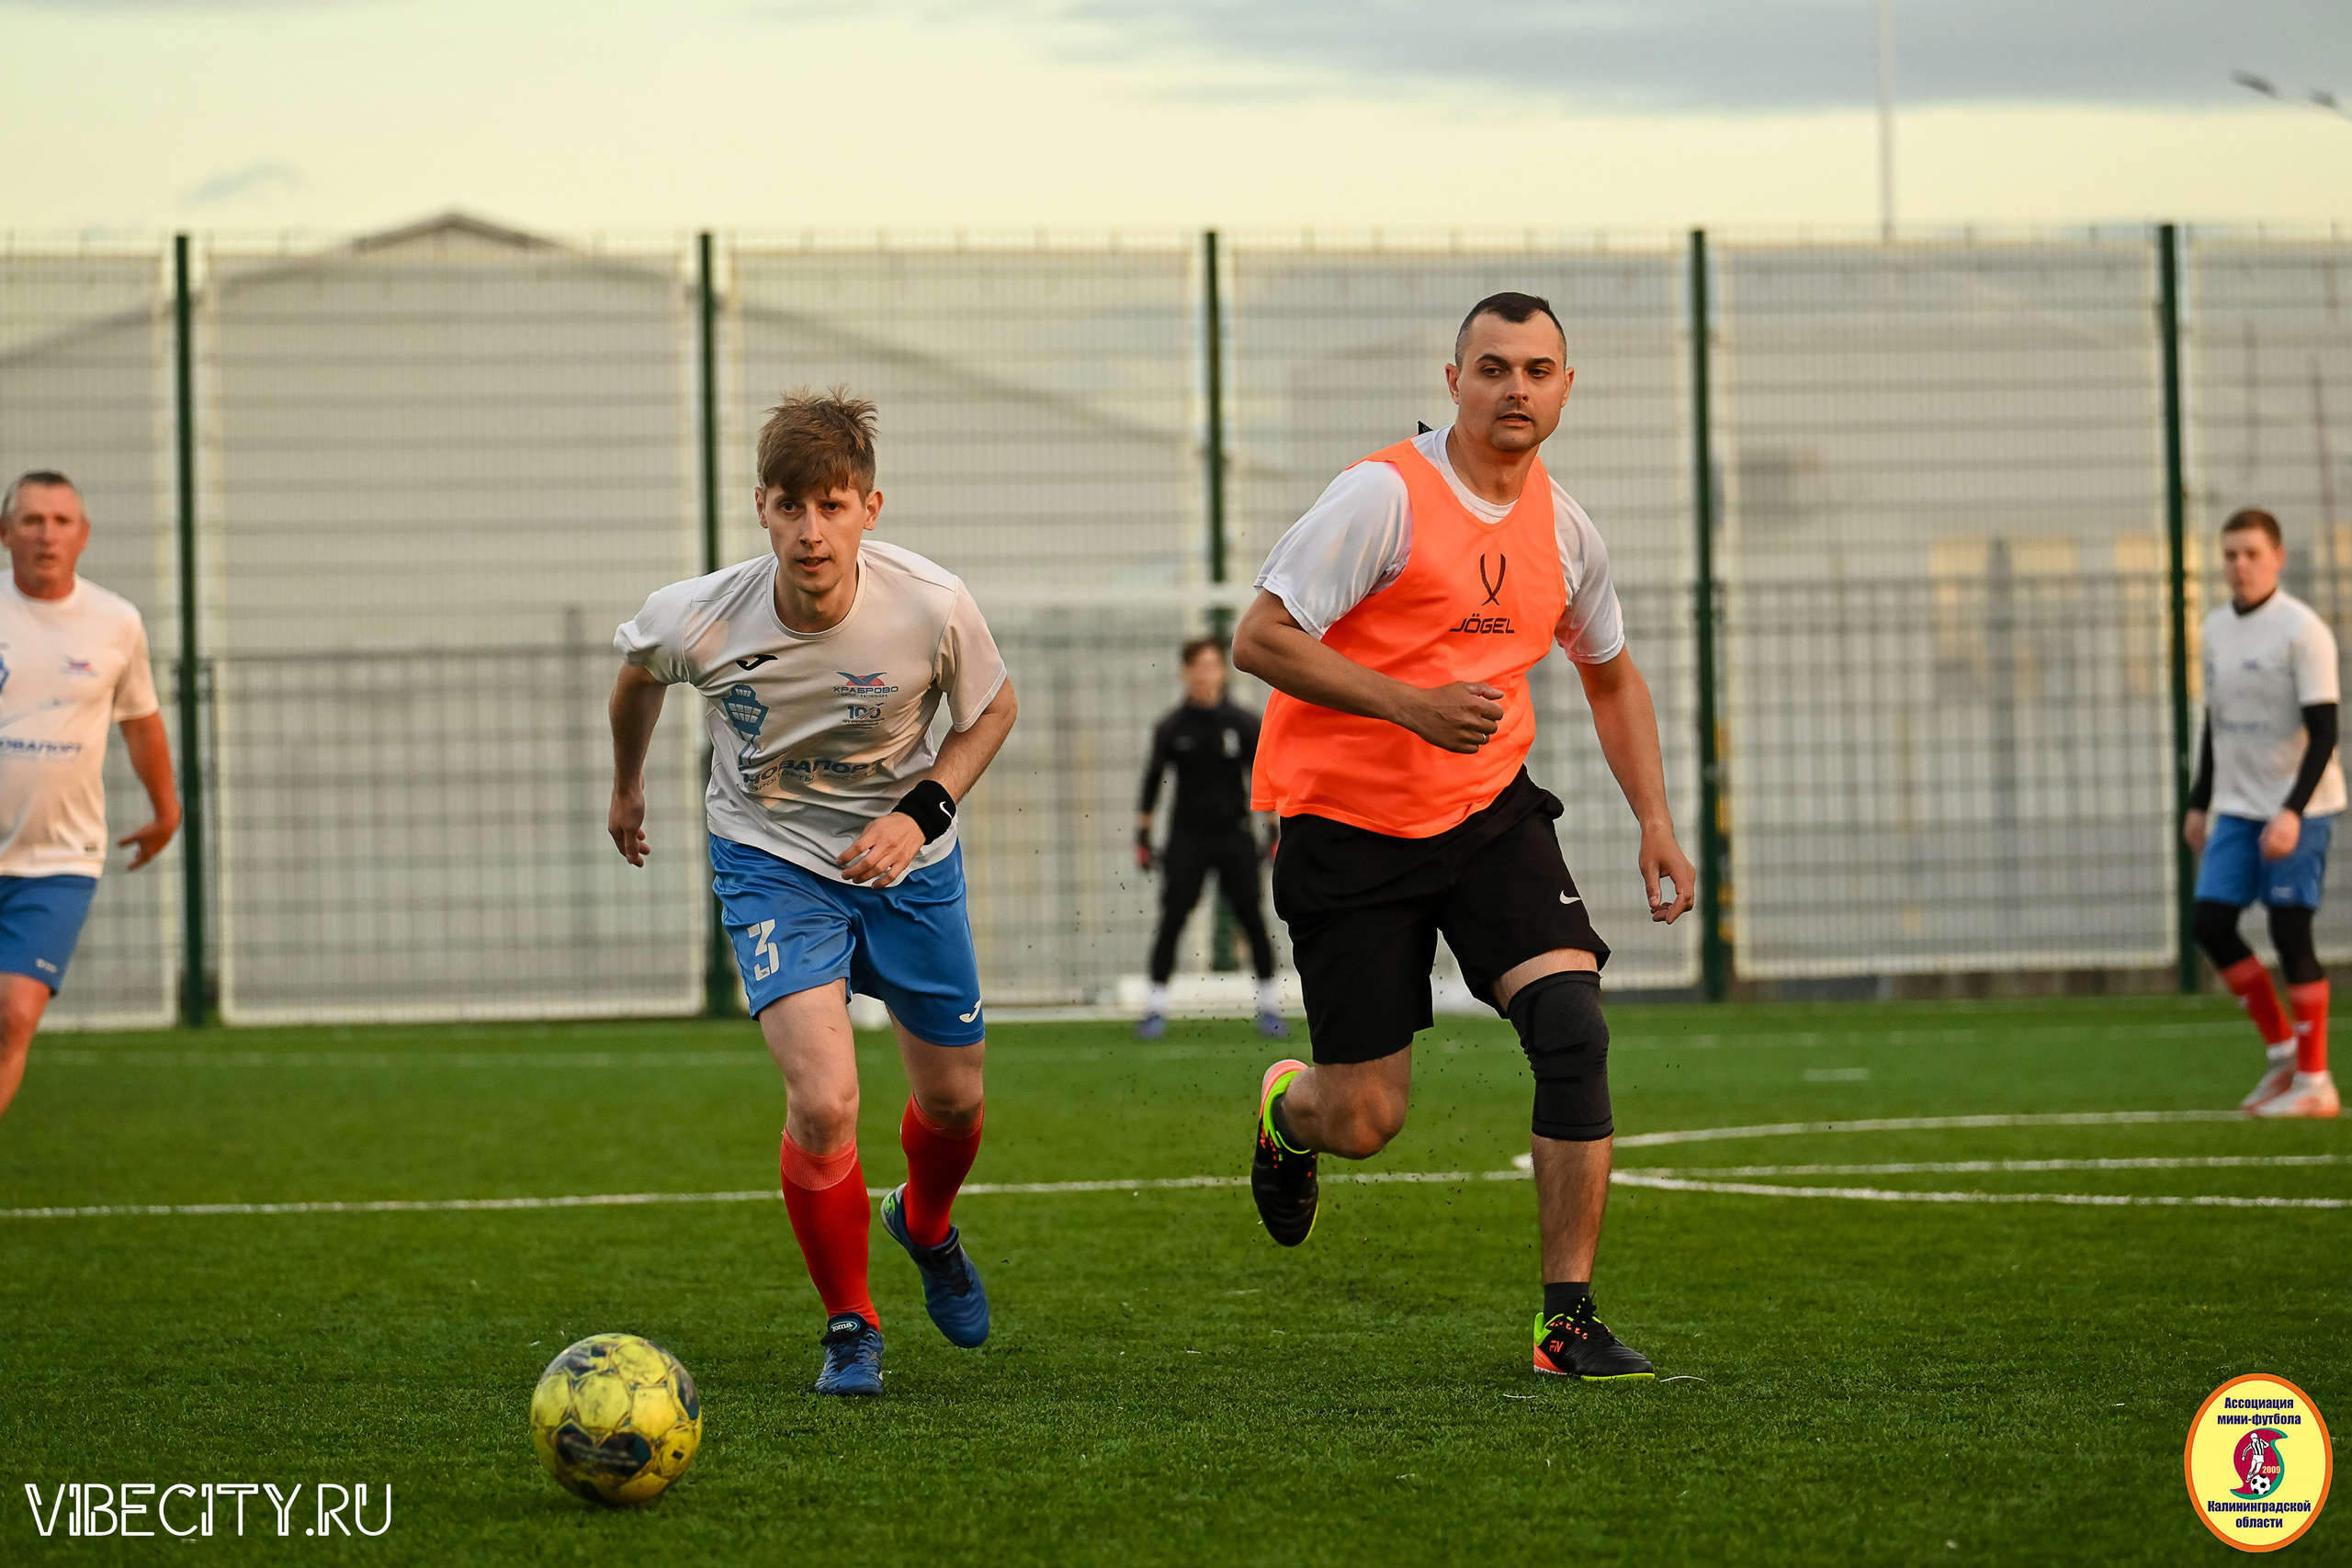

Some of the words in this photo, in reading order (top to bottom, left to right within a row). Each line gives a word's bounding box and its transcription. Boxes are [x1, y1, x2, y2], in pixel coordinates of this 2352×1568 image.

[1449, 613, 1515, 634] JÖGEL
[832, 685, 899, 694] ХРАБРОВО
[847, 705, 881, 719] 100
[747, 919, 780, 981] 3
